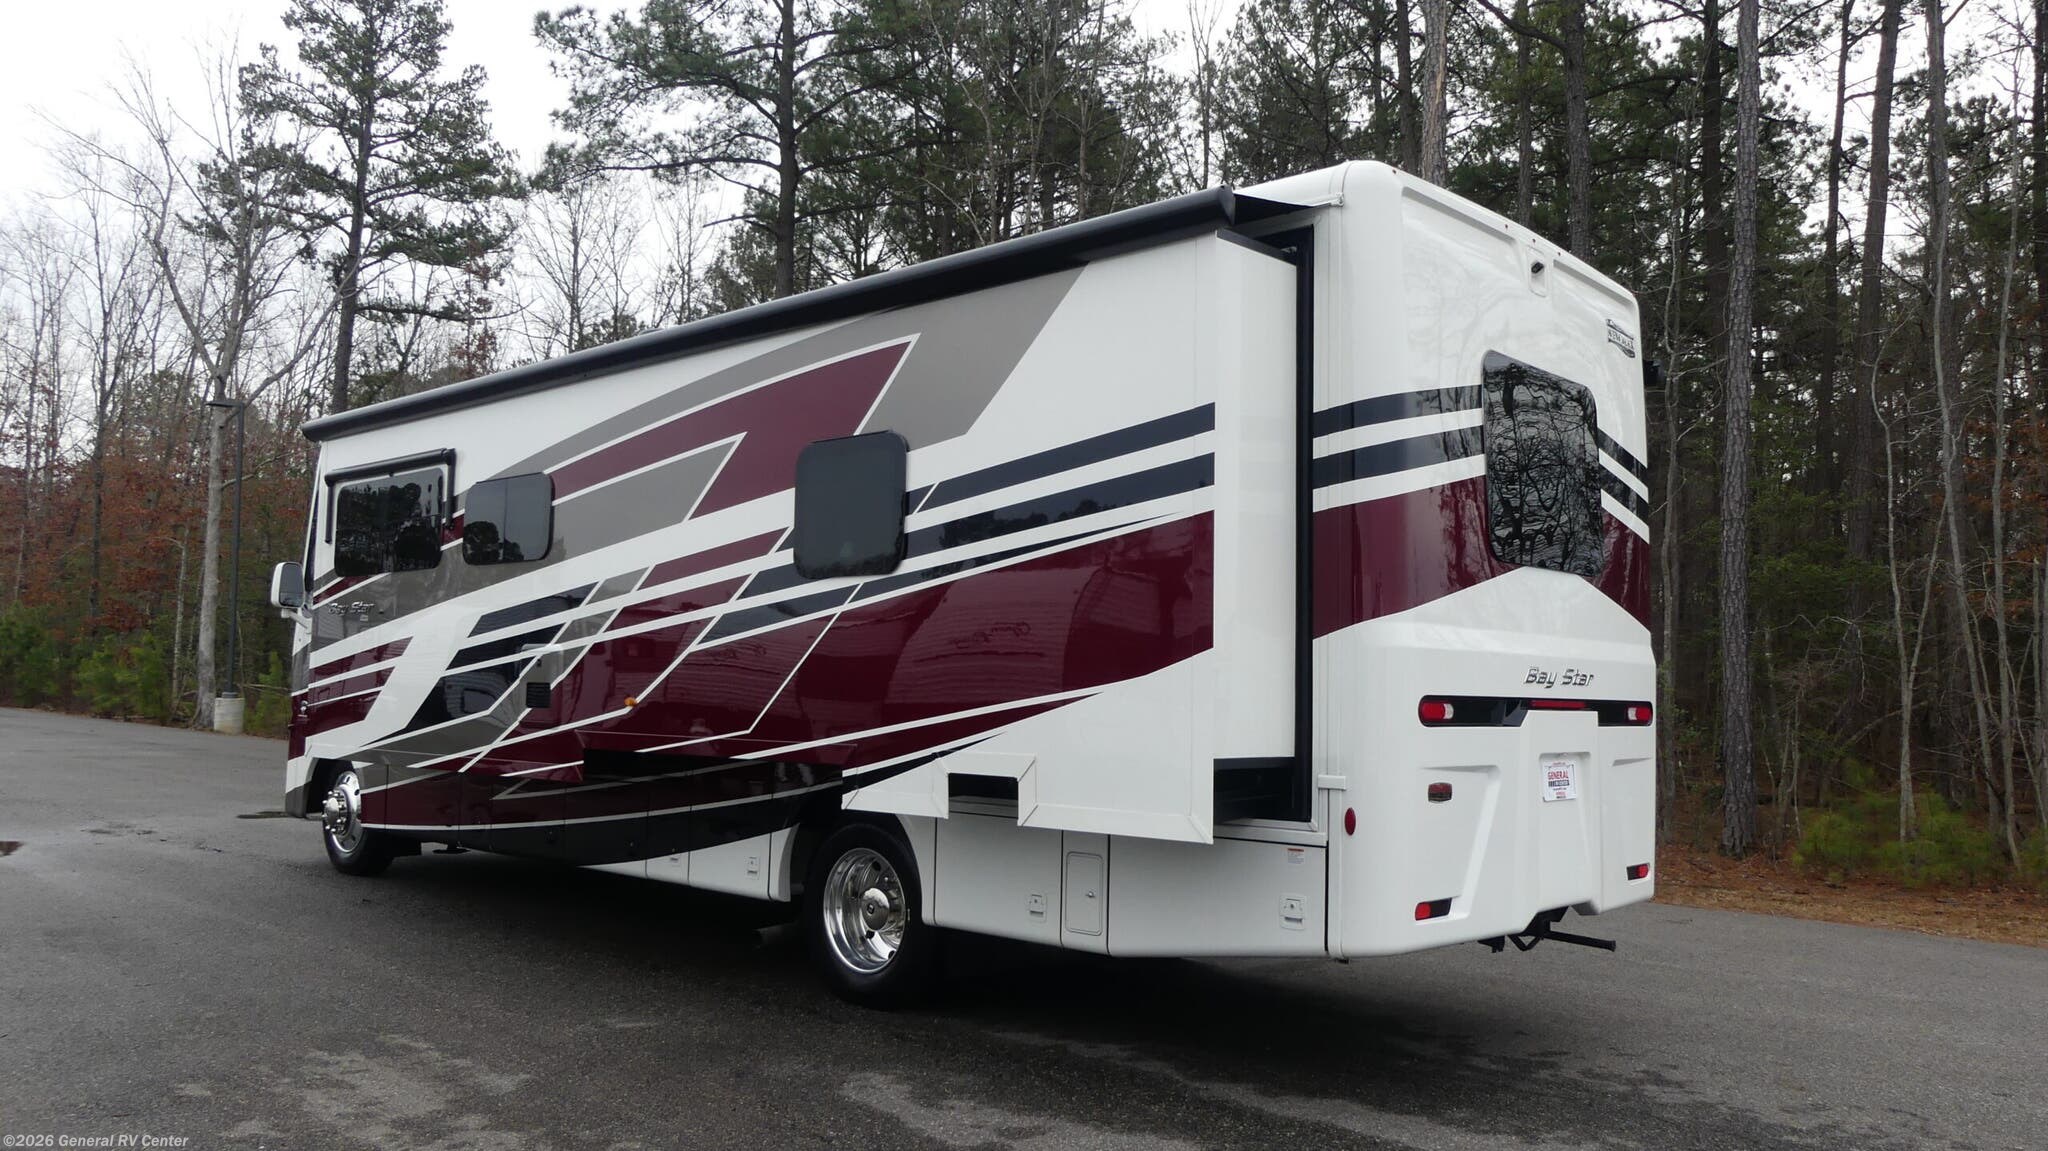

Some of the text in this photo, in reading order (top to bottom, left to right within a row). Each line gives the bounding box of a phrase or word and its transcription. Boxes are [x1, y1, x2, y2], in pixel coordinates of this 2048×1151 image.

[1524, 666, 1594, 689] Bay Star
[1548, 770, 1569, 780] GENERAL
